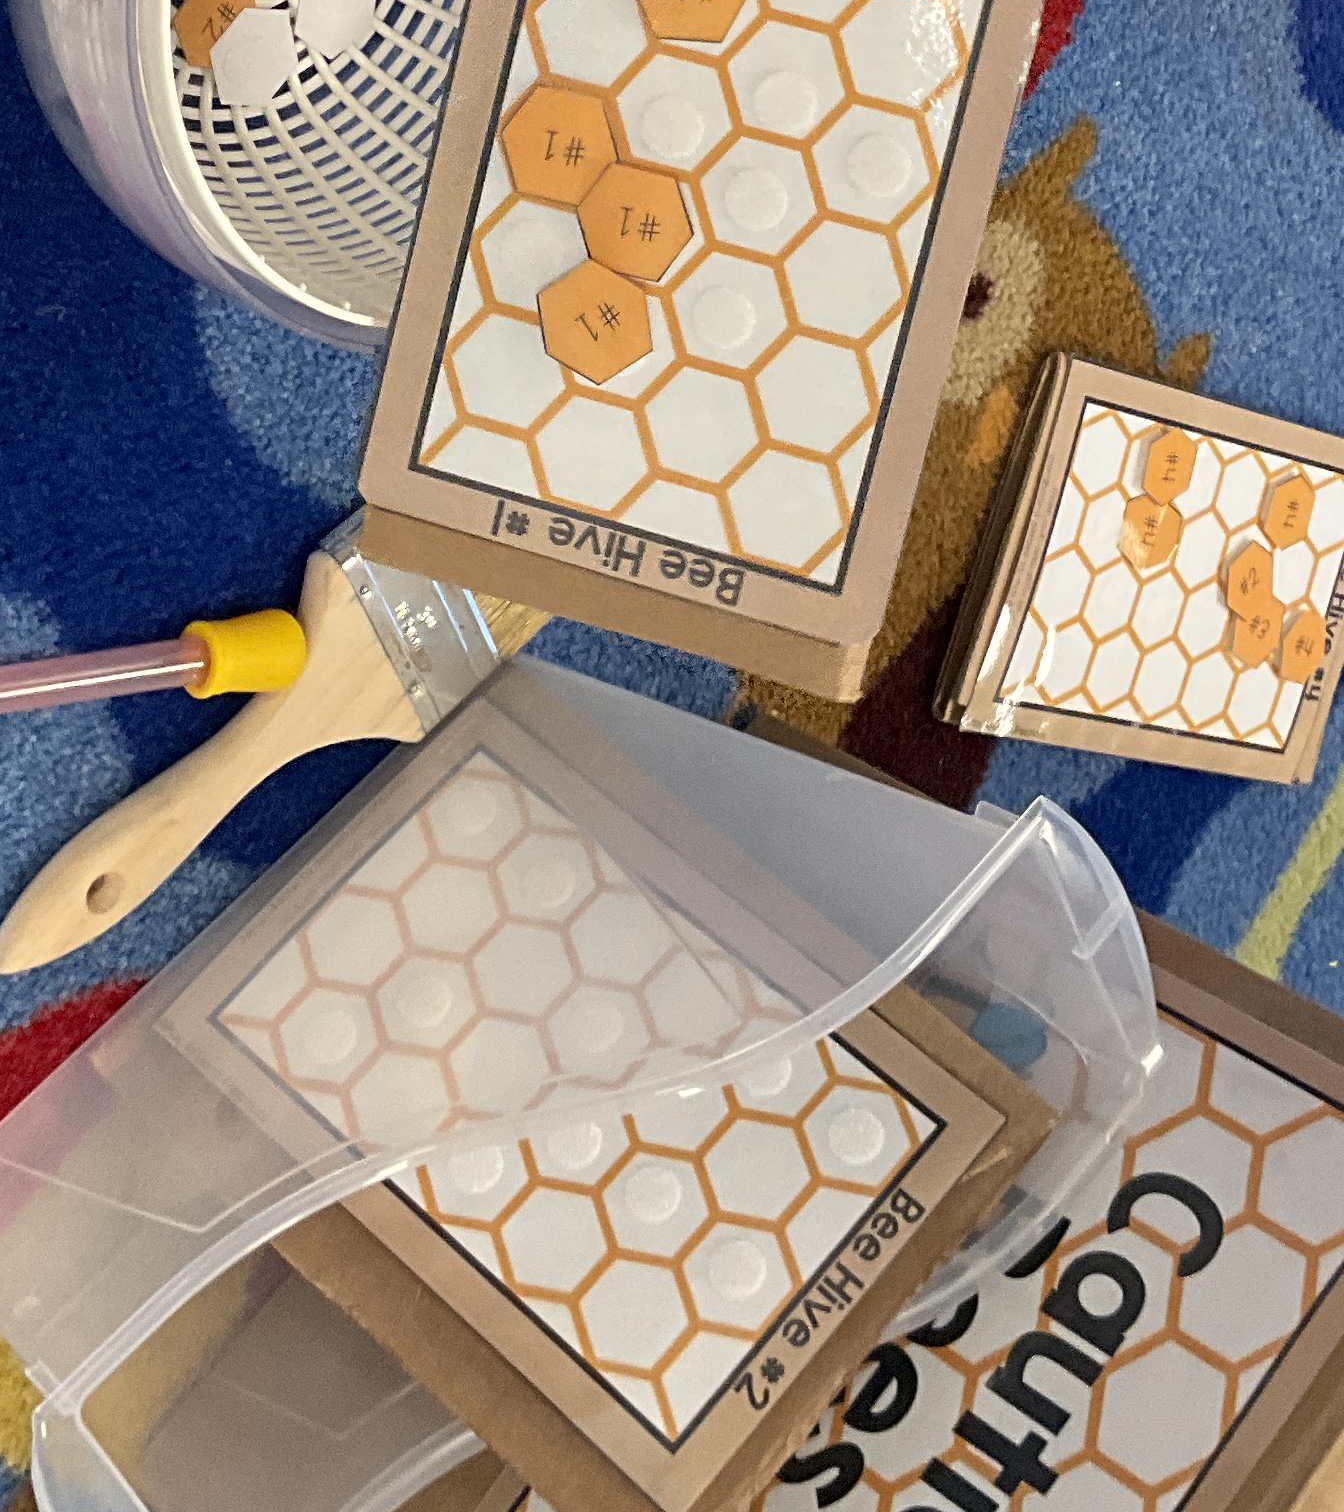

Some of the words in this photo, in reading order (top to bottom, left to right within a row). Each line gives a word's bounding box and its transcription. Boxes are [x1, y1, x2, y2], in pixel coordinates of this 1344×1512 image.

[544, 129, 586, 167] #1
[619, 205, 661, 243] #1
[575, 301, 622, 342] #1
[548, 516, 647, 578] Hive
[659, 549, 746, 607] Bee
[852, 1188, 925, 1261] Bee
[782, 1260, 865, 1348] Hive
[899, 1171, 1224, 1512] Cauti
[734, 1357, 785, 1410] #2
